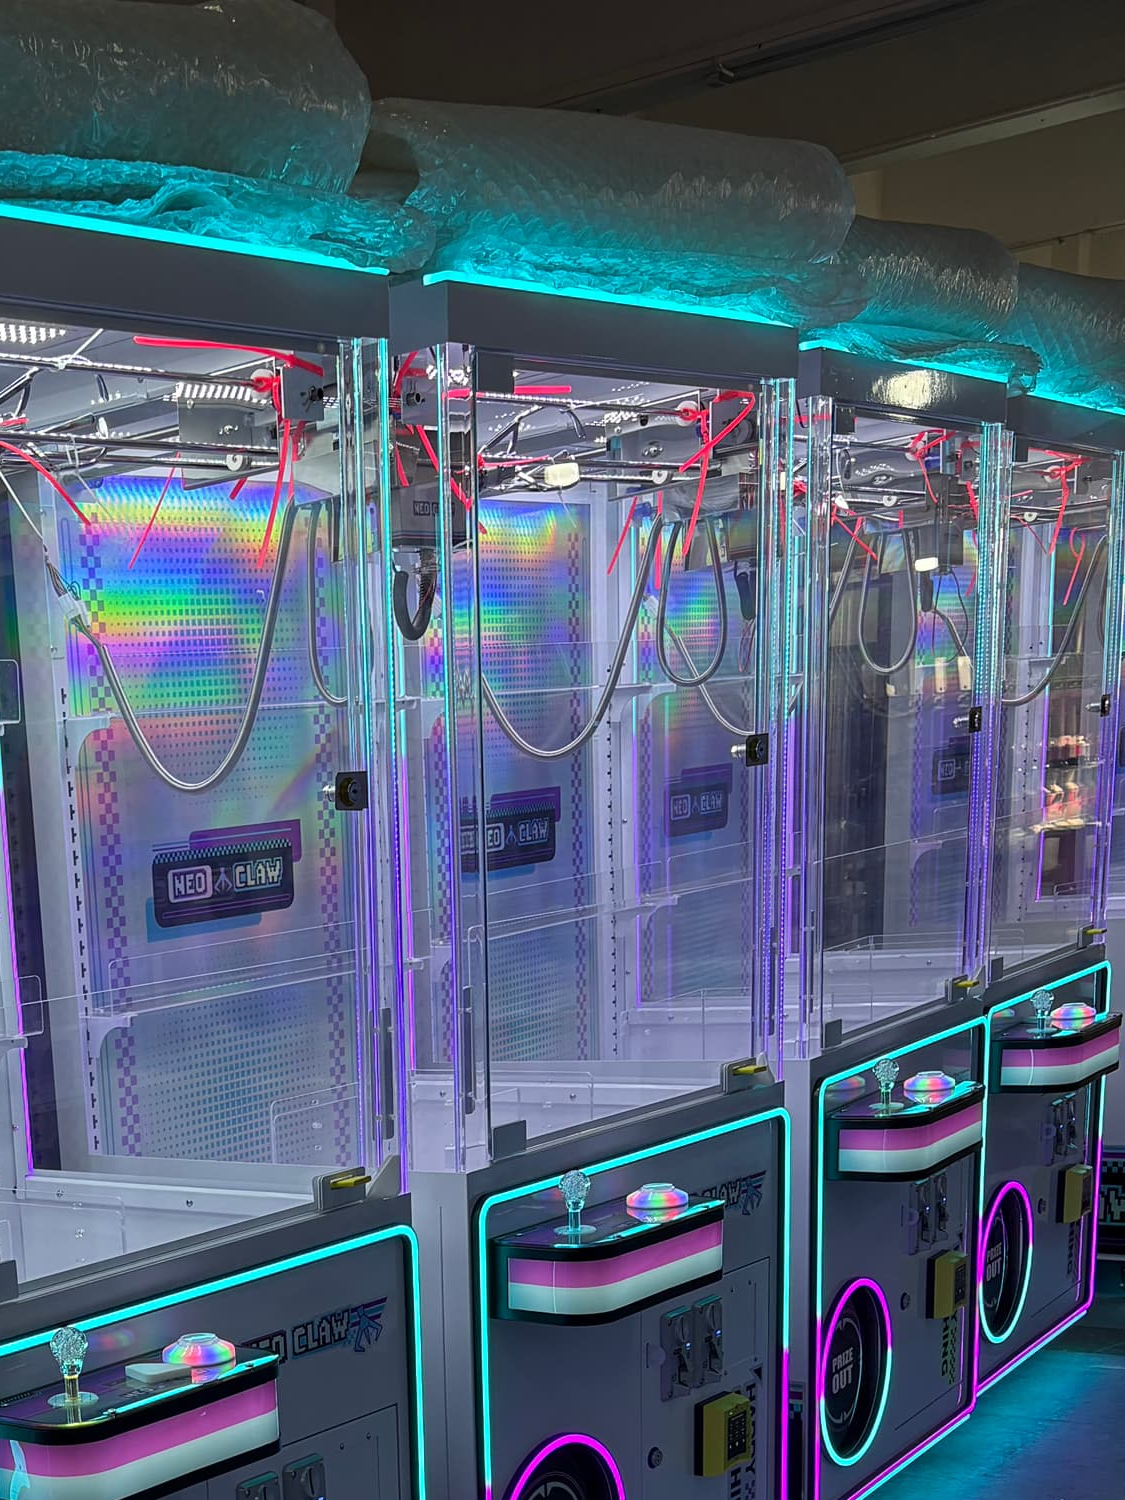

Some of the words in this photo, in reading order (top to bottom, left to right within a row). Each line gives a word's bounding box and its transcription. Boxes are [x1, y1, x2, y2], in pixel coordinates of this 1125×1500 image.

[518, 819, 548, 843] CLAW
[174, 871, 207, 897] NEO
[234, 859, 281, 889] CLAW
[293, 1311, 350, 1353] CLAW
[831, 1363, 854, 1395] OUT
